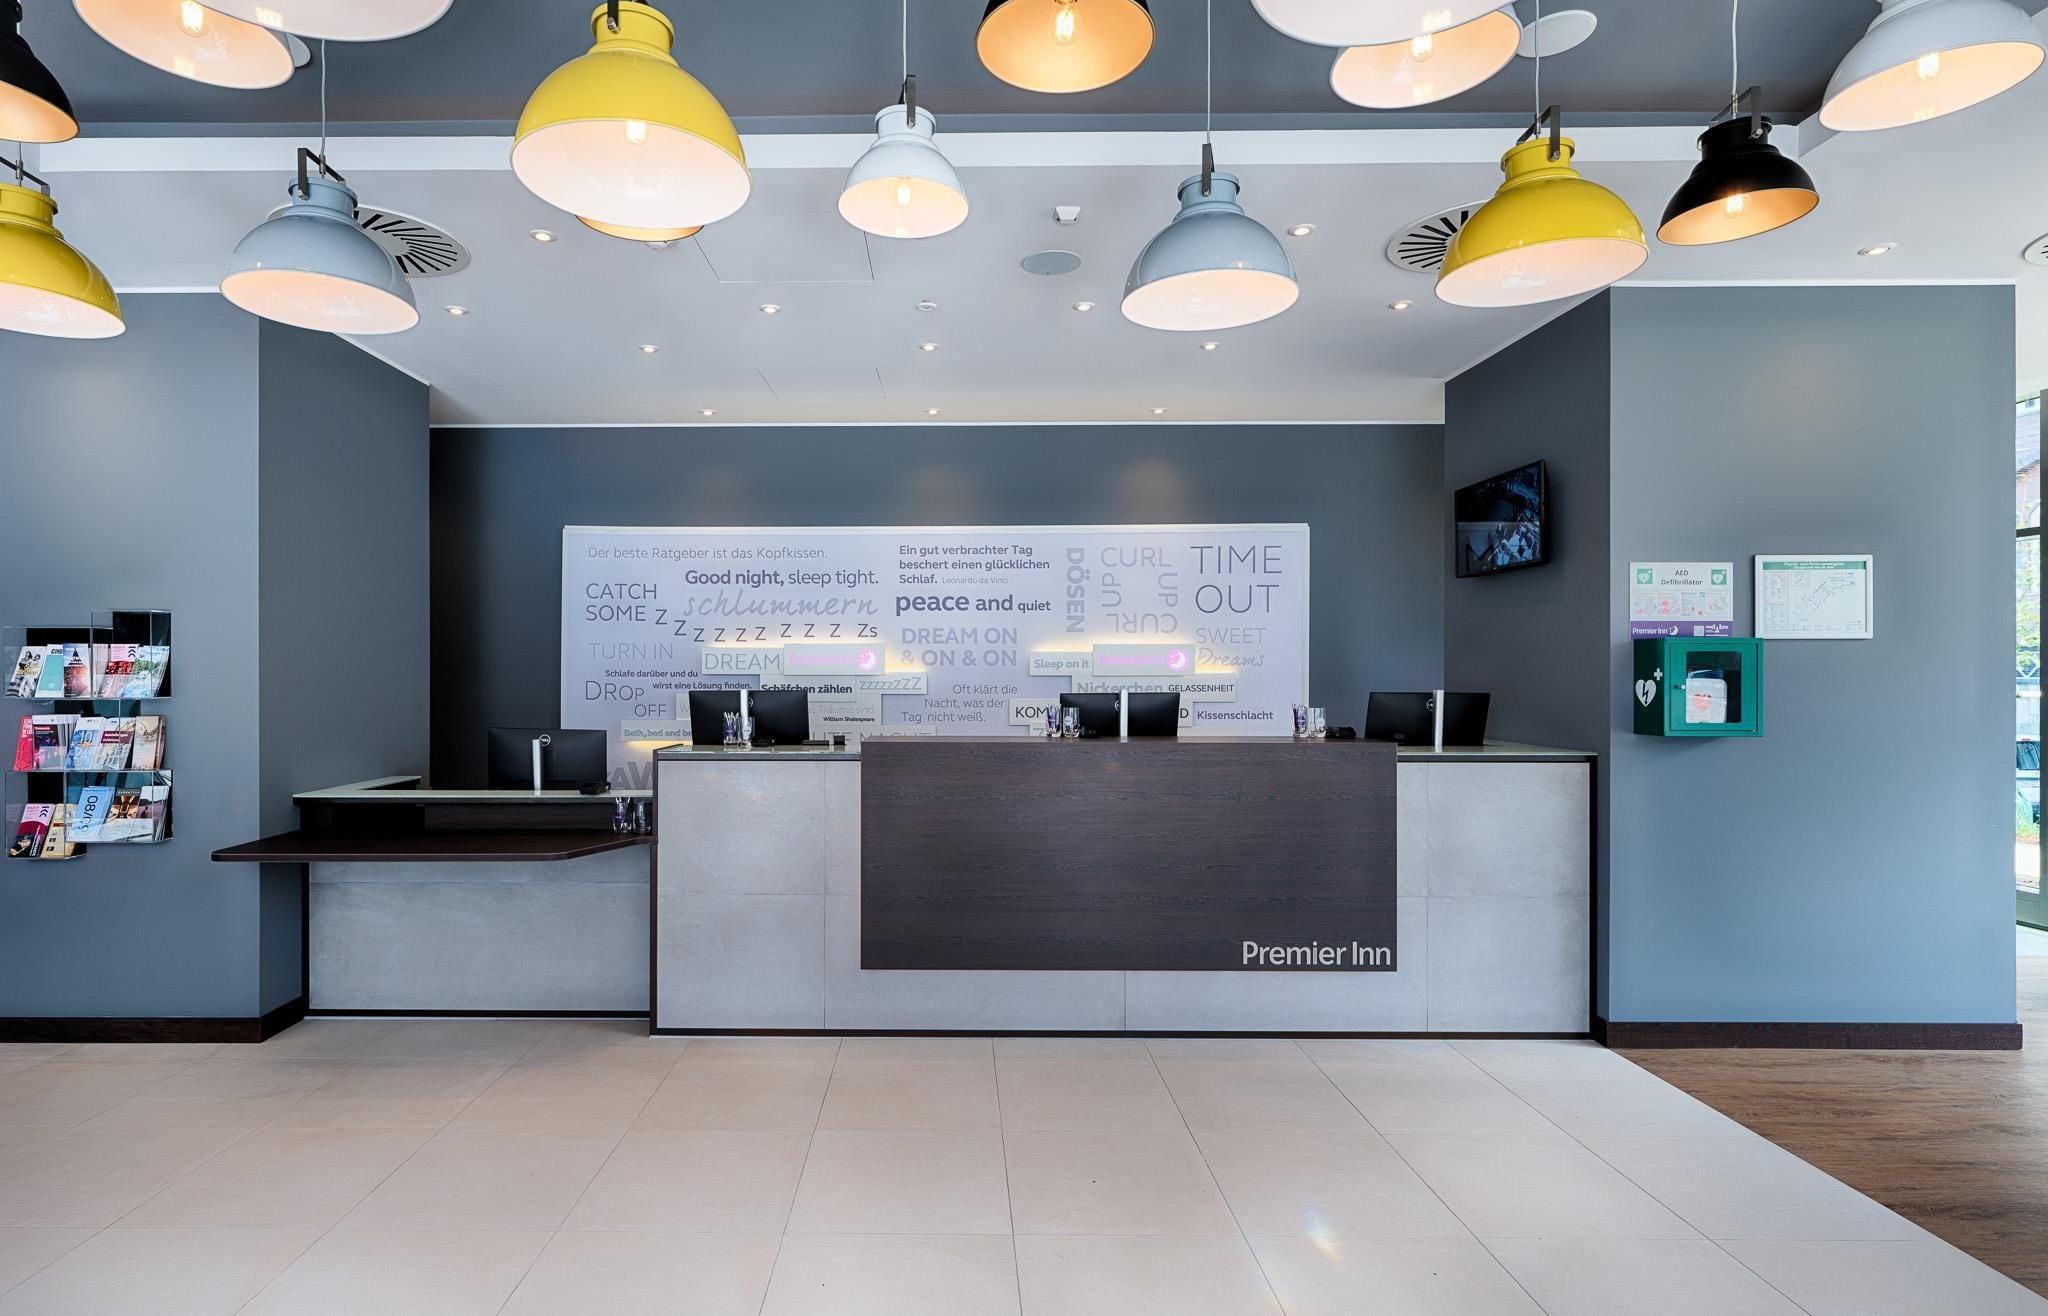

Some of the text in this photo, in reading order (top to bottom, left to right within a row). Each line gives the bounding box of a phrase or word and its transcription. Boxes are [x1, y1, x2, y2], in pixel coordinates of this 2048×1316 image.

[588, 547, 828, 561] Der beste Ratgeber ist das Kopfkissen.
[899, 545, 1033, 557] Ein gut verbrachter Tag
[1100, 546, 1173, 568] CURL
[899, 559, 1051, 572] beschert einen glücklichen
[1190, 545, 1283, 575] TIME
[685, 569, 879, 589] Good night, sleep tight.
[899, 574, 1009, 585] Schlaf. Leonardo da Vinci
[1674, 569, 1689, 577] AED
[1066, 547, 1091, 633] DÖSEN
[1101, 572, 1123, 608] UP
[1157, 572, 1179, 608] UP
[1660, 578, 1704, 586] Defibrillator
[586, 583, 657, 600] CATCH
[1195, 584, 1280, 614] OUT
[683, 588, 879, 617] schlummern
[896, 594, 1052, 617] peace and quiet
[586, 605, 647, 622] SOME
[1106, 613, 1179, 634] CURL
[1632, 627, 1668, 635] Premier Inn
[901, 628, 1018, 645] DREAM ON
[1195, 627, 1268, 644] SWEET
[587, 642, 673, 660] TURN IN
[901, 650, 1018, 667] & ON & ON
[1196, 646, 1265, 668] Dreams
[704, 652, 781, 671] DREAM
[1033, 659, 1064, 671] Sleep
[1065, 660, 1080, 669] on
[1081, 659, 1090, 669] it
[605, 669, 699, 678] Schlafe darüber und du
[585, 680, 645, 701] DROP
[652, 681, 753, 691] wirst eine Lösung finden.
[761, 683, 853, 694] Schäfchen zählen
[952, 684, 1018, 695] Oft klärt die
[1077, 682, 1163, 693] Nickerchen
[1168, 684, 1235, 693] GELASSENHEIT
[634, 704, 667, 718] OFF
[924, 698, 1005, 710] Nacht, was der
[901, 711, 986, 725] Tag nicht weiß.
[1197, 711, 1274, 720] Kissenschlacht
[664, 728, 681, 738] and
[1242, 940, 1391, 966] Premier Inn
